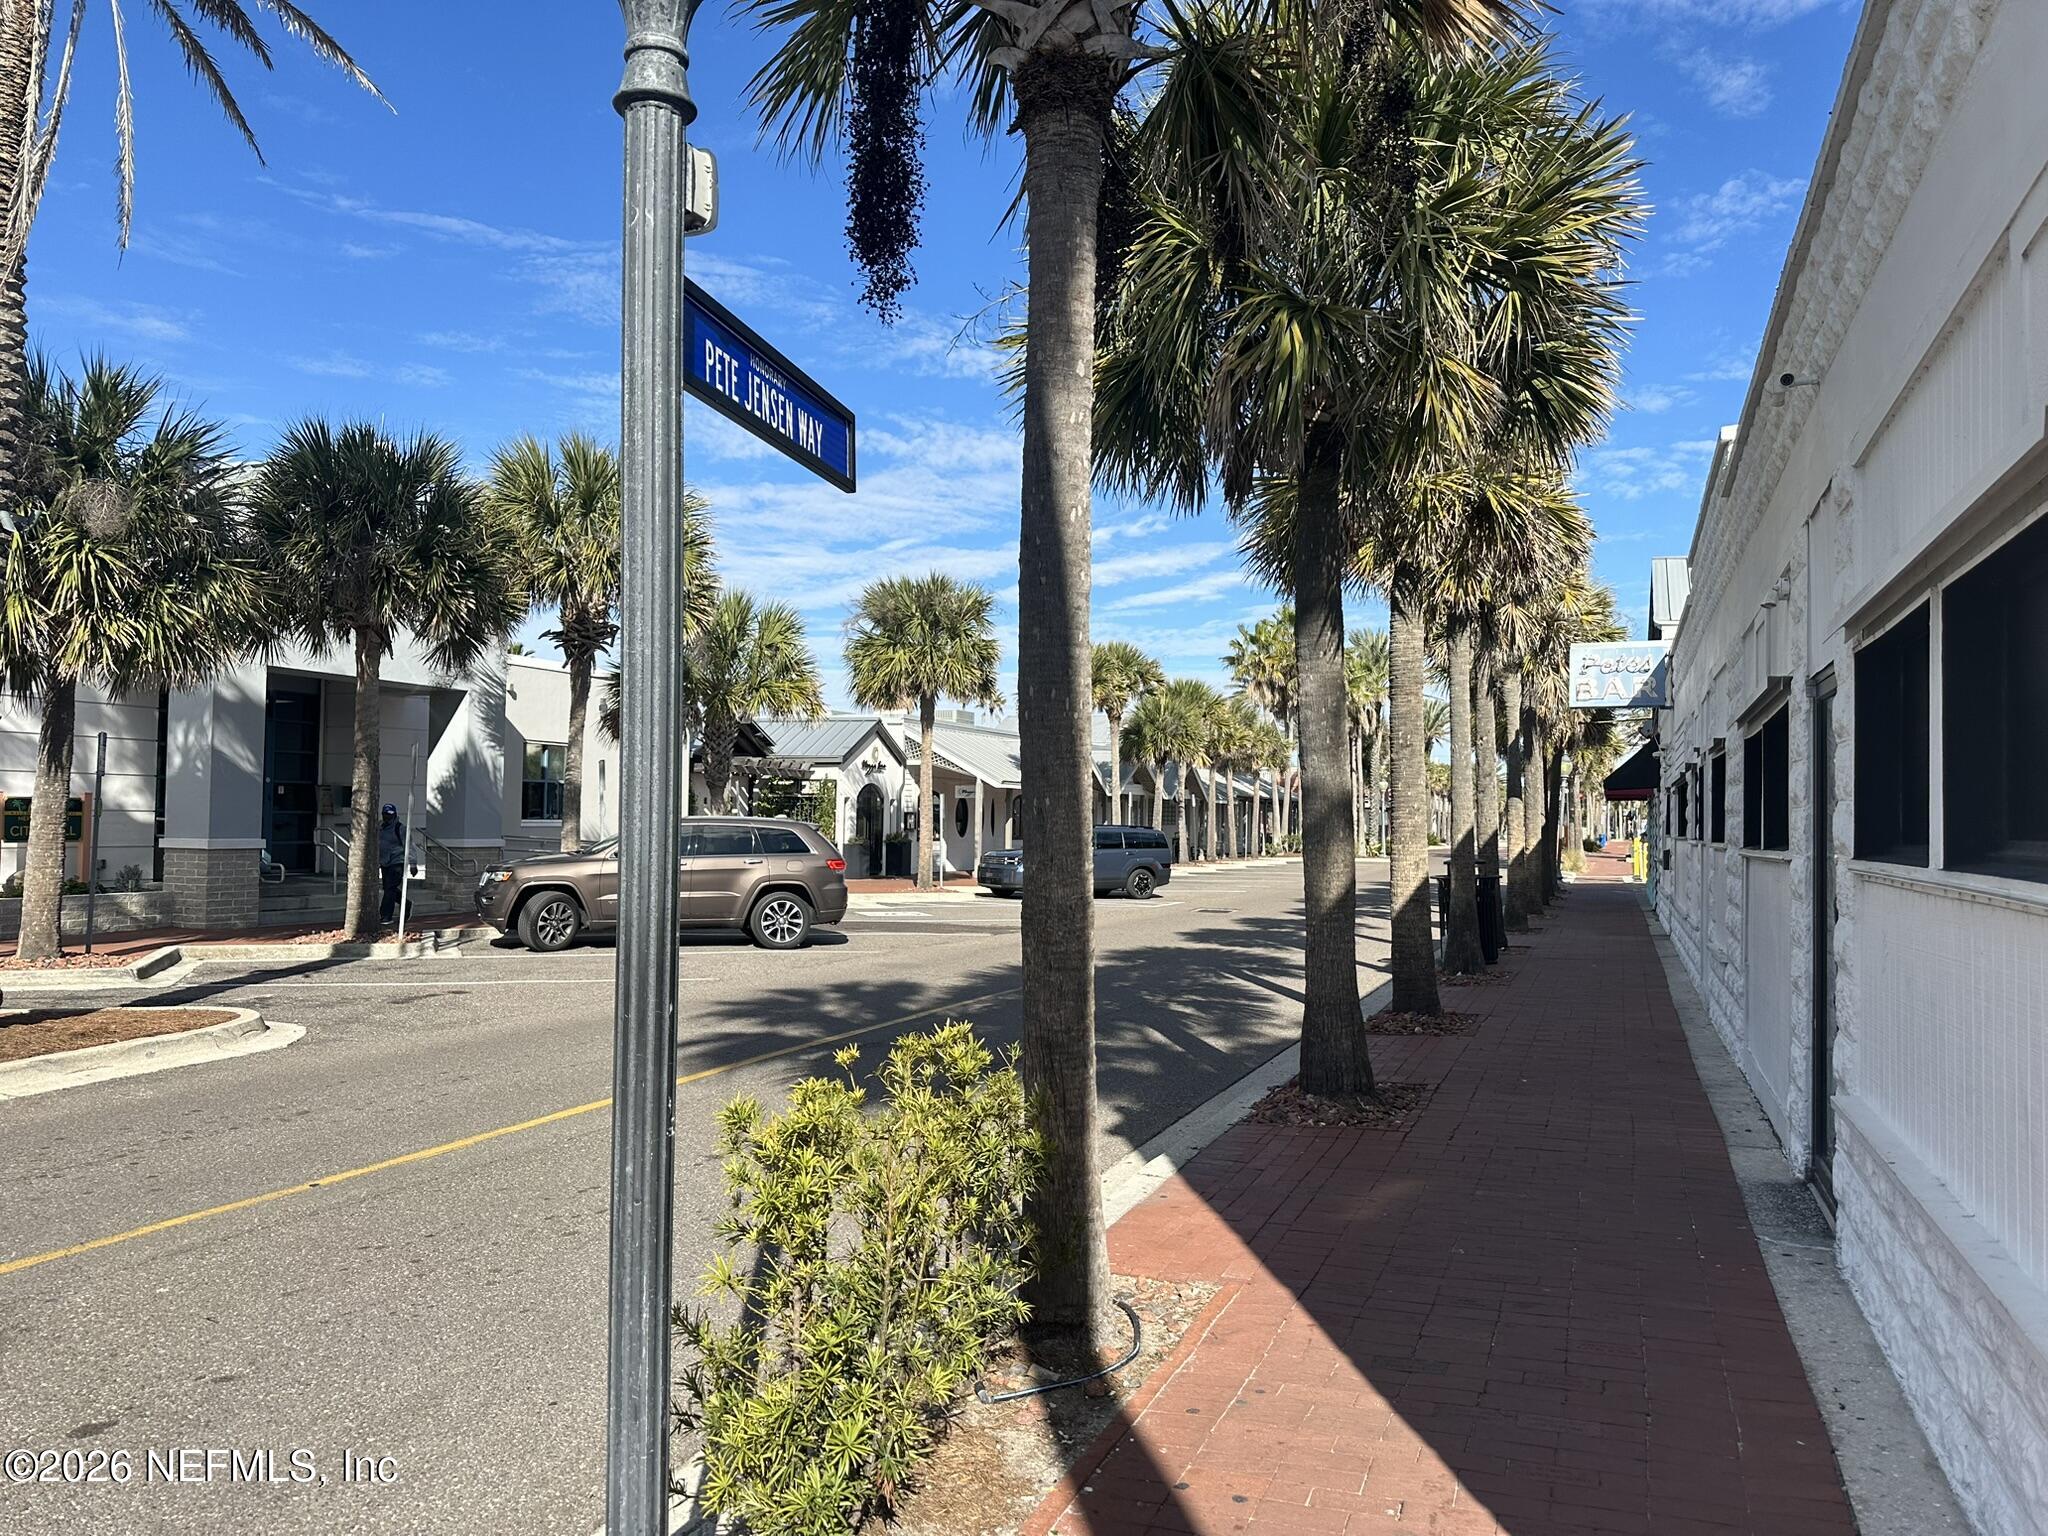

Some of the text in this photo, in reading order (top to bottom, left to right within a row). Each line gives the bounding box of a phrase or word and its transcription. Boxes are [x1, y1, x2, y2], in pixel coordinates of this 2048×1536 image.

[749, 353, 787, 391] HONORARY
[705, 338, 823, 458] PETE JENSEN WAY
[1575, 676, 1658, 702] BAR
[10, 825, 29, 837] CIT
